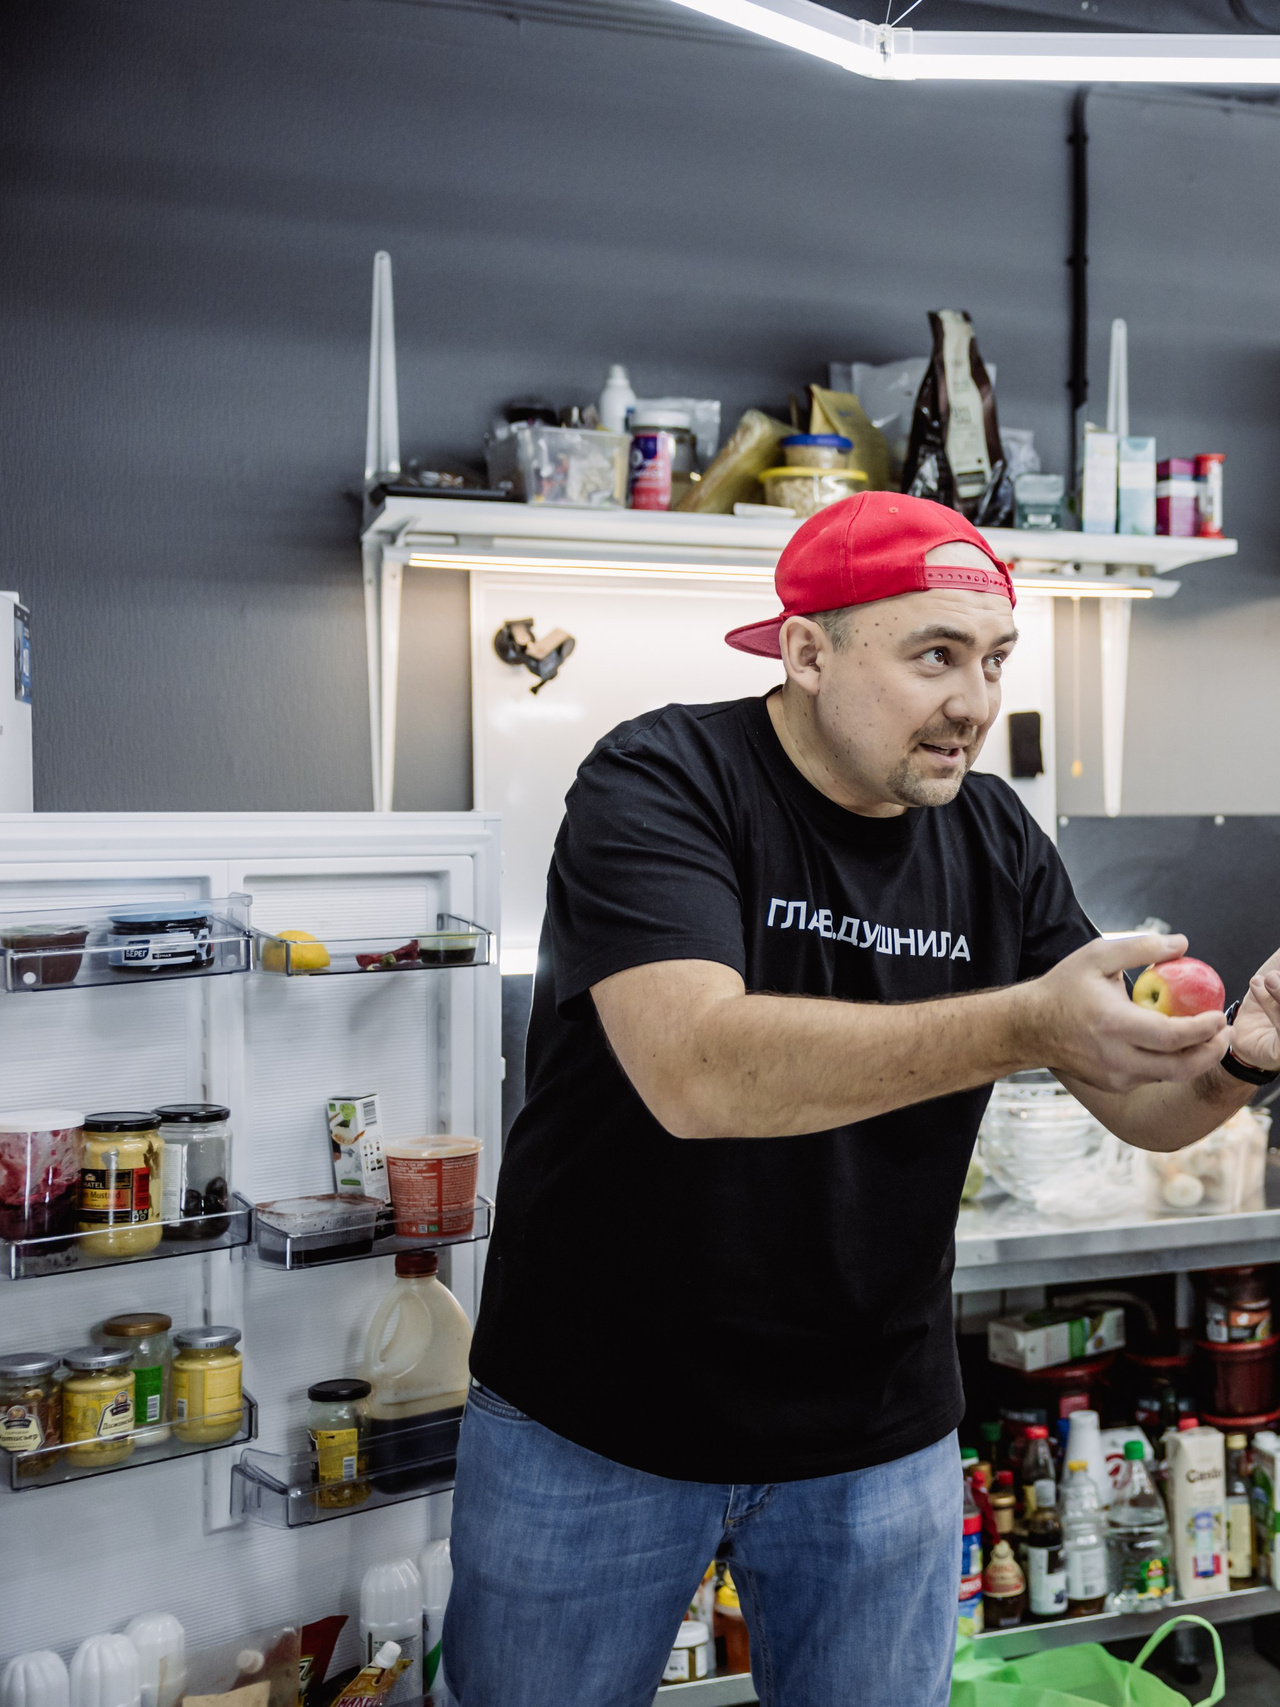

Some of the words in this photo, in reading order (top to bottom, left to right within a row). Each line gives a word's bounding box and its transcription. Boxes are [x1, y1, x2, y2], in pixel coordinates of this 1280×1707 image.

[767, 898, 971, 962] ГЛАВ.ДУШНИЛА
[125, 949, 148, 958] БЕРЕГ
[81, 1181, 104, 1189] HATEL
